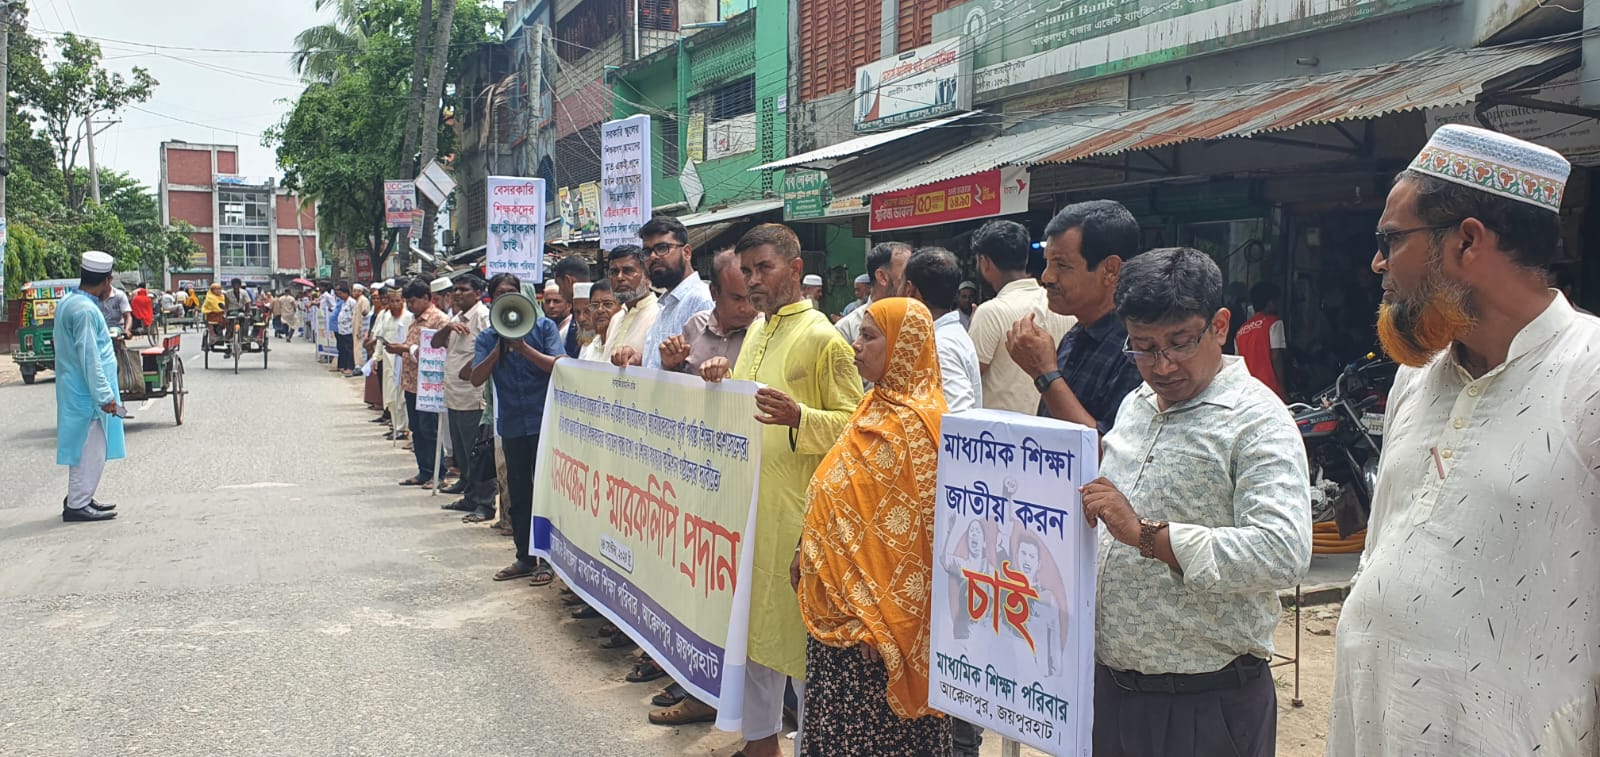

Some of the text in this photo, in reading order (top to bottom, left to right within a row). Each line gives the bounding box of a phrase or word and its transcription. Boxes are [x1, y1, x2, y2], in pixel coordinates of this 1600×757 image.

[1035, 8, 1074, 28] Islami
[1079, 0, 1115, 16] Bank
[1070, 24, 1092, 36] বাজার
[494, 182, 534, 195] বেসরকারি
[493, 202, 536, 215] শিক্ষকদের
[918, 196, 931, 213] ৫০
[491, 220, 536, 234] জাতীয়করণ
[503, 240, 518, 251] চাই
[489, 260, 506, 270] মাধ্যমিক
[508, 260, 519, 270] শিক্ষা
[699, 420, 715, 453] শিক্ষা
[943, 430, 1075, 482] মাধ্যমিক শিক্ষা
[945, 481, 1069, 540] জাতীয় করন
[590, 469, 600, 518] ও
[606, 473, 679, 568] স্মারকলিপি
[680, 512, 740, 600] প্রদান
[578, 559, 600, 588] মাধ্যমিক
[601, 568, 616, 601] শিক্ষা
[617, 582, 640, 624] পরিবার,
[641, 603, 674, 655] আক্কেলপুর,
[675, 631, 719, 679] জয়পুরহাট
[962, 560, 1039, 654] চাই
[936, 651, 1069, 725] মাধ্যমিক শিক্ষা পরিবার
[939, 680, 993, 720] আক্কেলপুর,
[997, 703, 1055, 740] জয়পুরহাট
